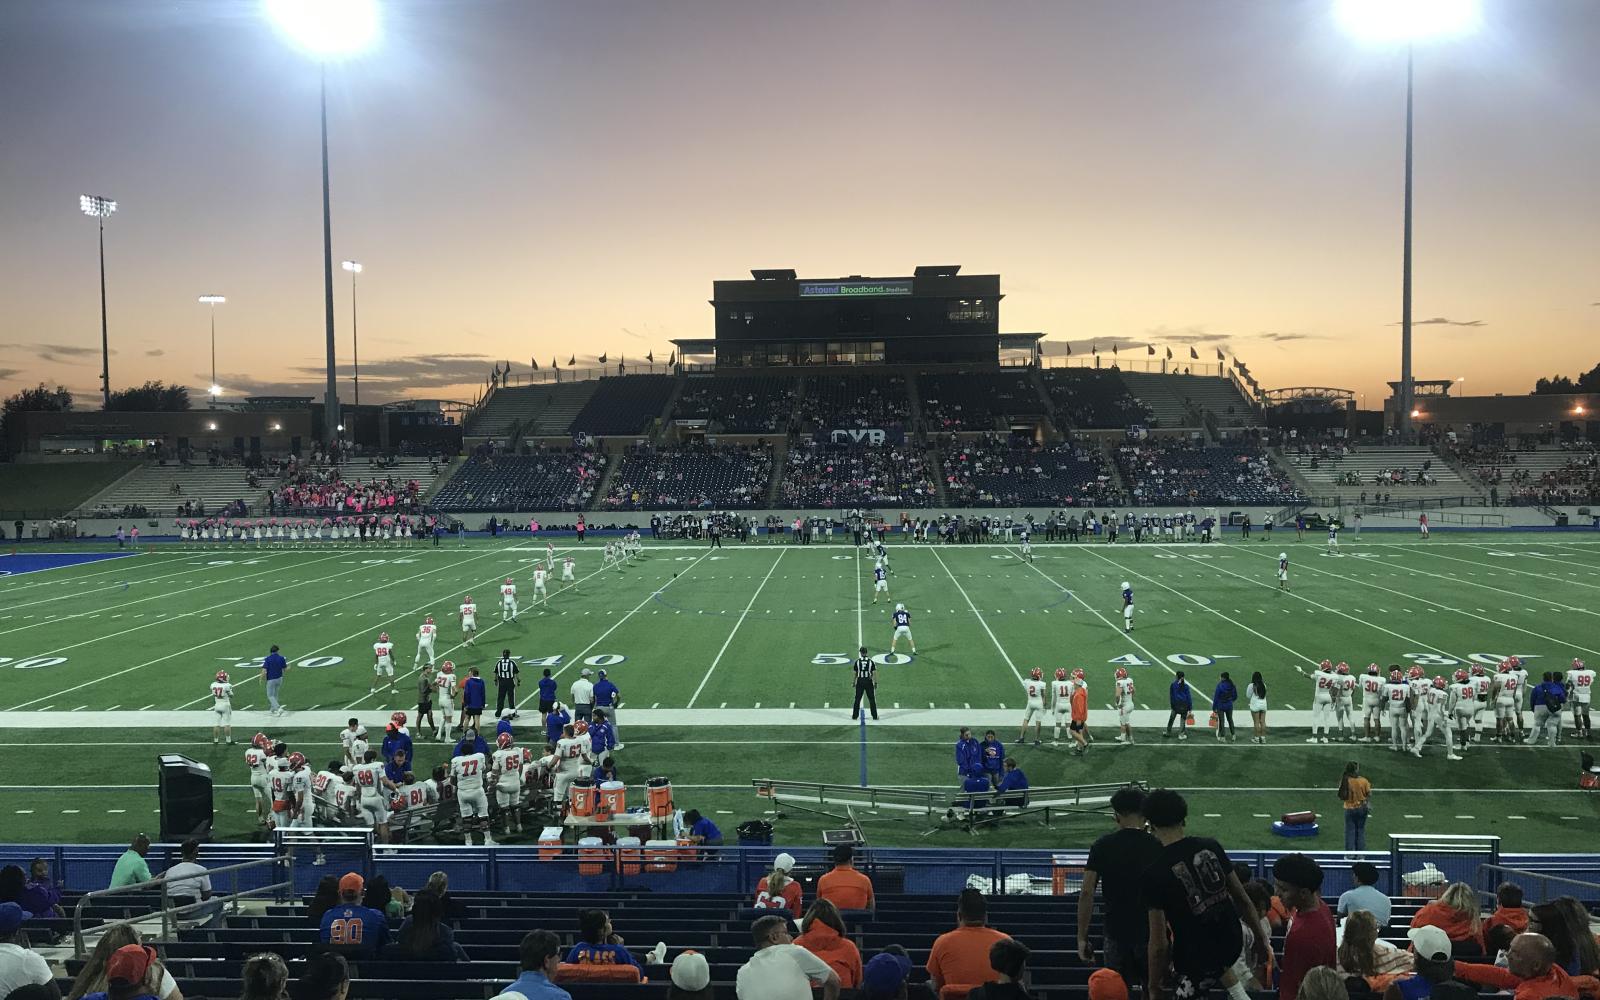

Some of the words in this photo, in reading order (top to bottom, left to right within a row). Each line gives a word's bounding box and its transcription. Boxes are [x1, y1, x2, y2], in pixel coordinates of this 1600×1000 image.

[804, 286, 839, 294] Astound
[463, 607, 473, 615] 25
[898, 614, 907, 623] 84
[861, 661, 867, 670] F
[1318, 678, 1332, 689] 24
[1344, 681, 1354, 690] 34
[1504, 679, 1516, 690] 42
[1577, 675, 1591, 686] 99
[1029, 685, 1036, 697] 2
[1059, 685, 1068, 697] 11
[1365, 680, 1378, 693] 30
[1392, 690, 1403, 700] 21
[1461, 687, 1473, 699] 98
[505, 755, 519, 770] 65
[462, 760, 478, 777] 77
[358, 770, 374, 785] 88
[410, 789, 423, 805] 81
[576, 793, 584, 802] G
[607, 795, 616, 804] G
[1171, 849, 1226, 906] 10
[330, 918, 363, 944] 90
